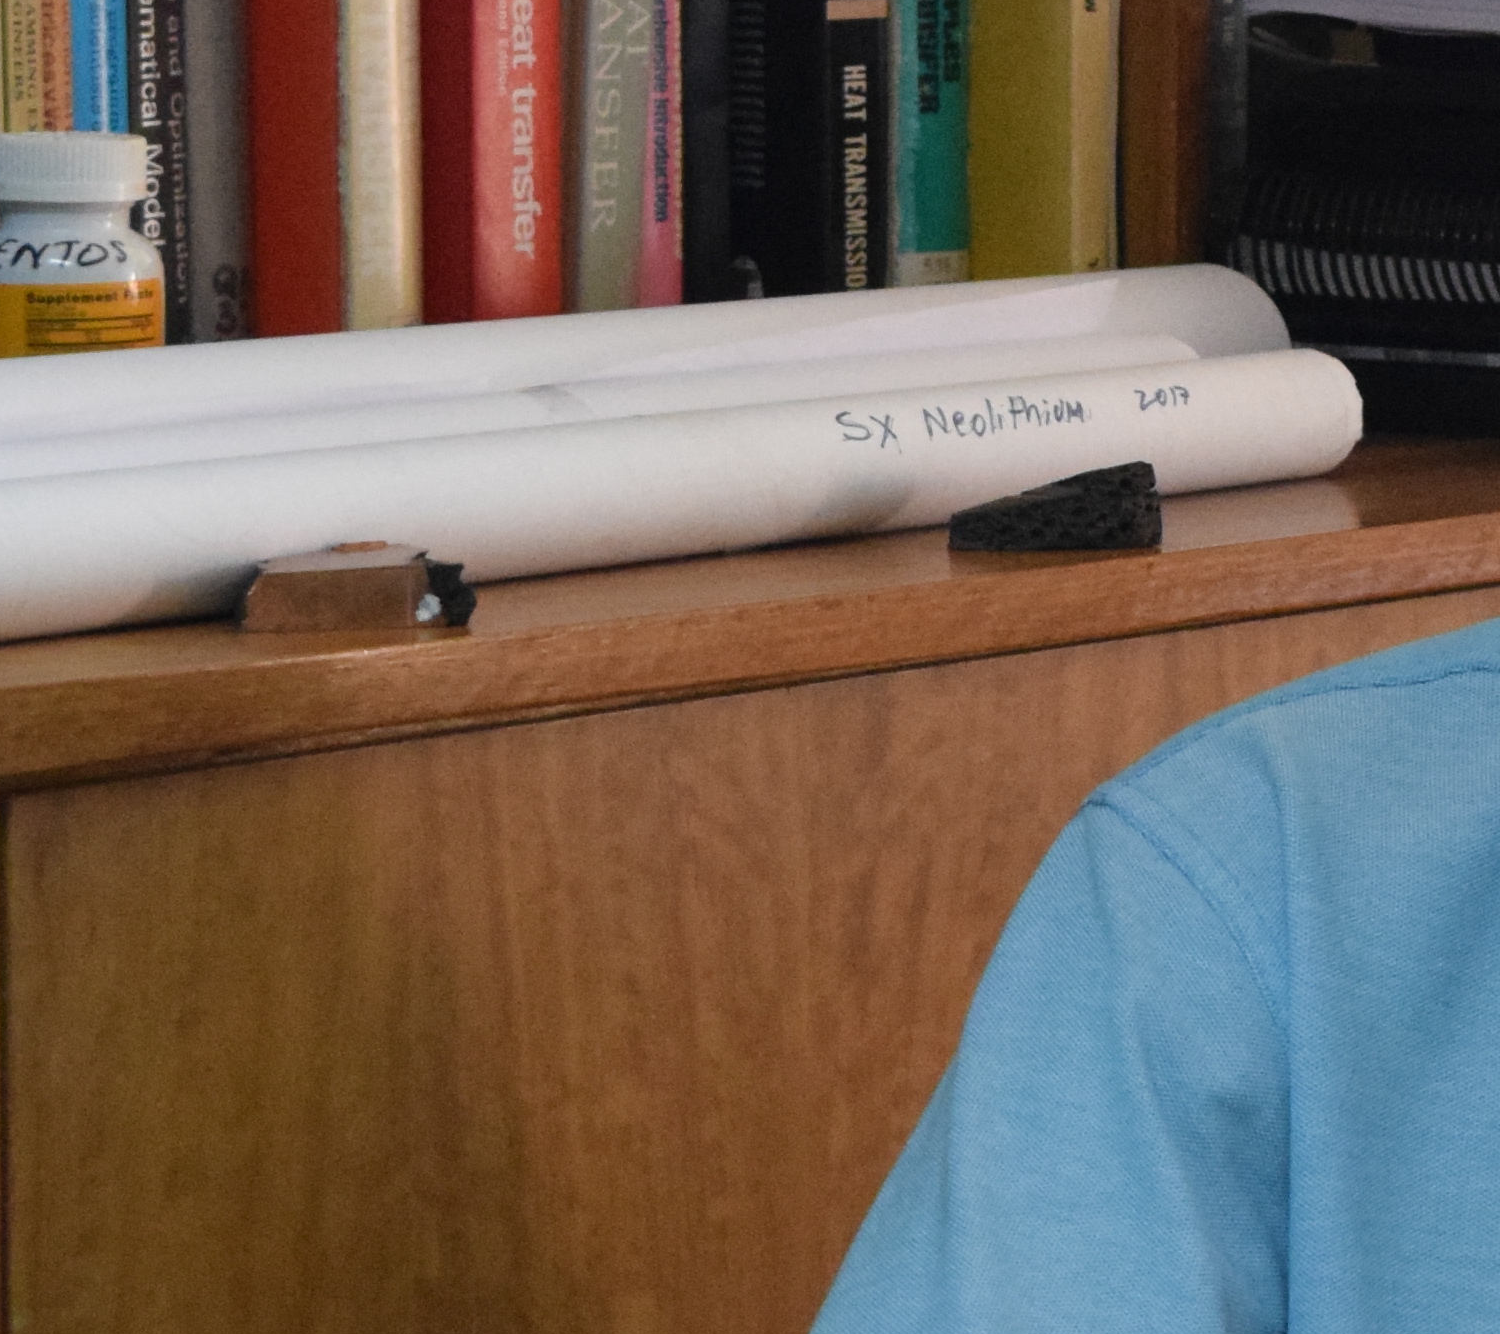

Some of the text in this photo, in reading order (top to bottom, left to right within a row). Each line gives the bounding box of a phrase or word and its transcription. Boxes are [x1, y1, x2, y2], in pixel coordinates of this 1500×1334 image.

[166, 15, 186, 77] and
[140, 141, 167, 247] Model
[168, 91, 192, 305] Optimization
[509, 81, 544, 262] transfer
[842, 64, 868, 289] HEAT TRANSMISSIO
[1133, 383, 1193, 412] 2017
